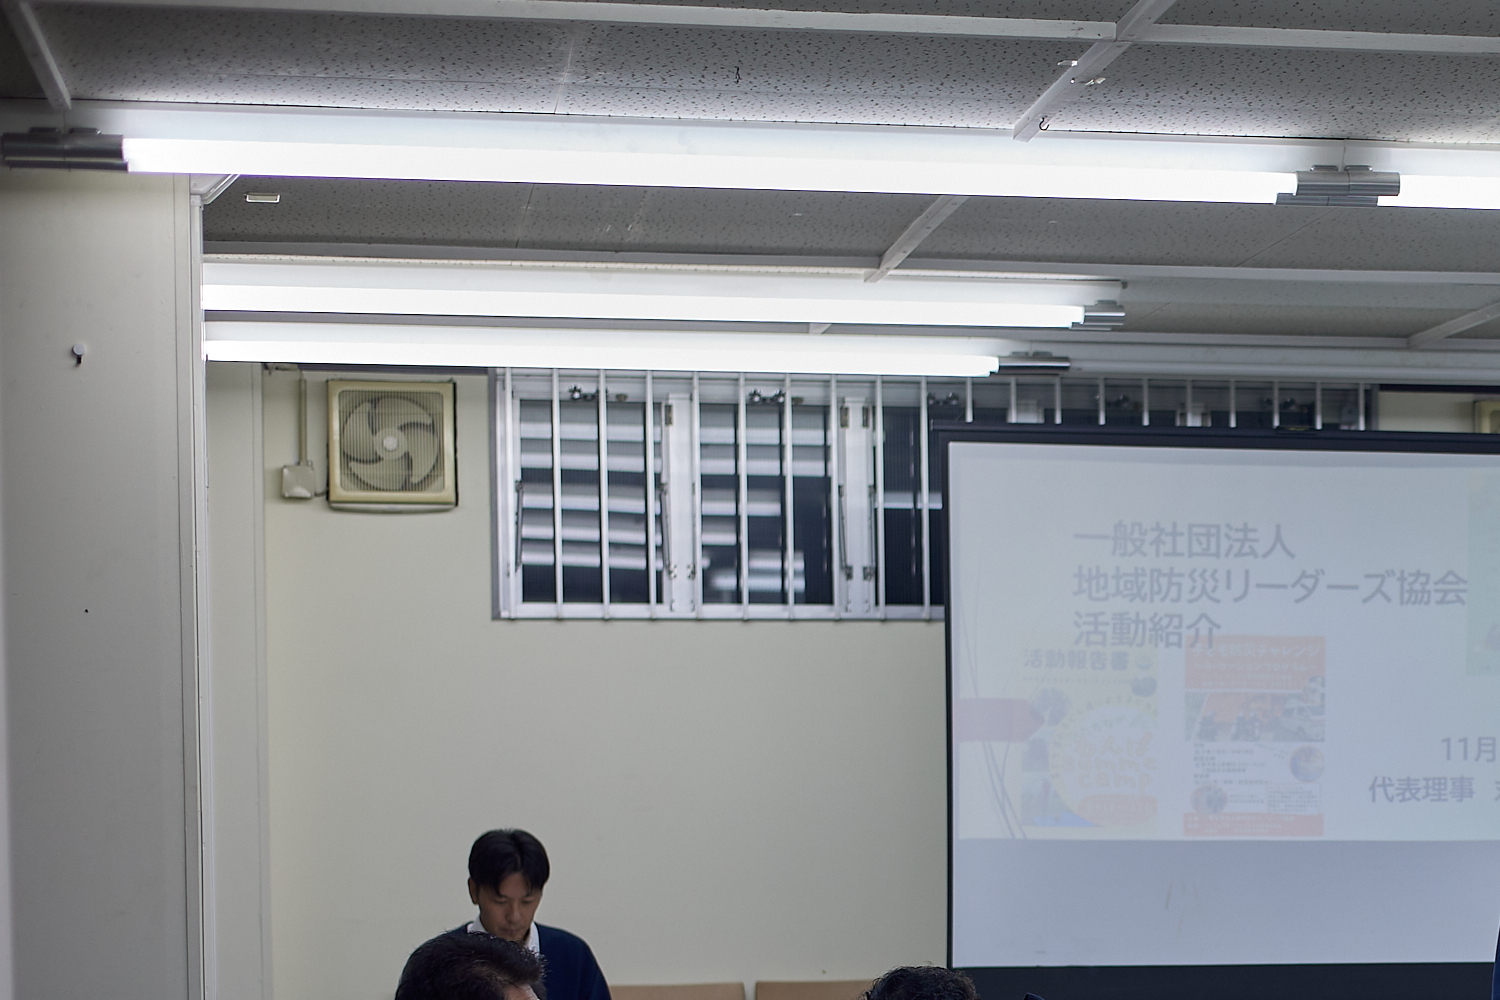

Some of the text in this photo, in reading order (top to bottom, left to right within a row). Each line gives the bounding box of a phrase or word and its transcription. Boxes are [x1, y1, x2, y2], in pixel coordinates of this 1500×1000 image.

[1073, 520, 1296, 559] 一般社団法人
[1072, 565, 1468, 607] 地域防災リーダーズ協会
[1073, 611, 1222, 649] 活動紹介
[1023, 648, 1130, 671] 活動報告書
[1369, 776, 1476, 803] 代表理事
